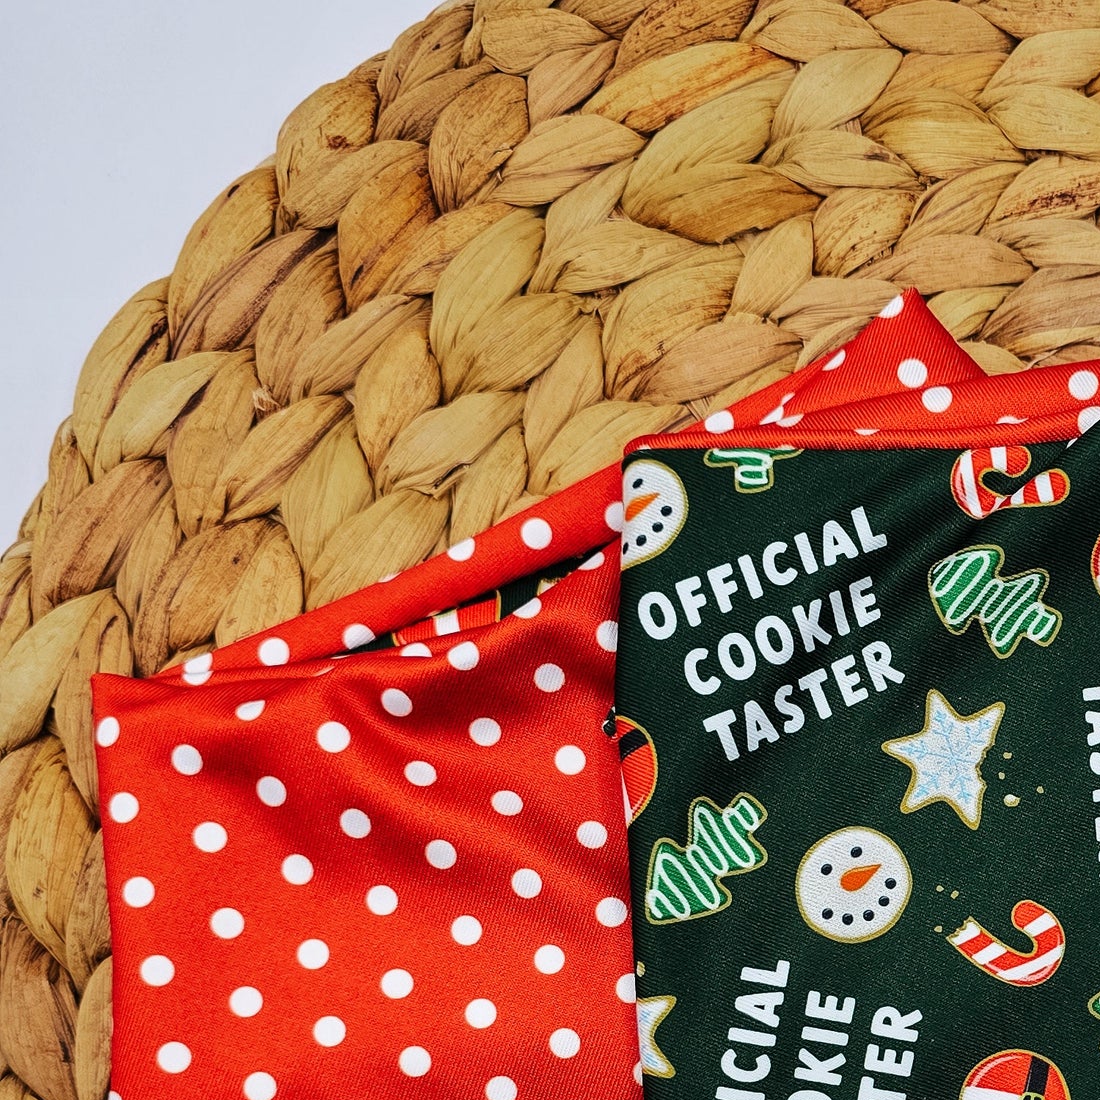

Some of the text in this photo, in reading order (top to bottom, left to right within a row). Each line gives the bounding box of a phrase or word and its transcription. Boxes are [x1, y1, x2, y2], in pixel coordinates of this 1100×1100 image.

[637, 505, 888, 641] OFFICIAL
[683, 575, 882, 696] COOKIE
[702, 640, 906, 762] TASTER
